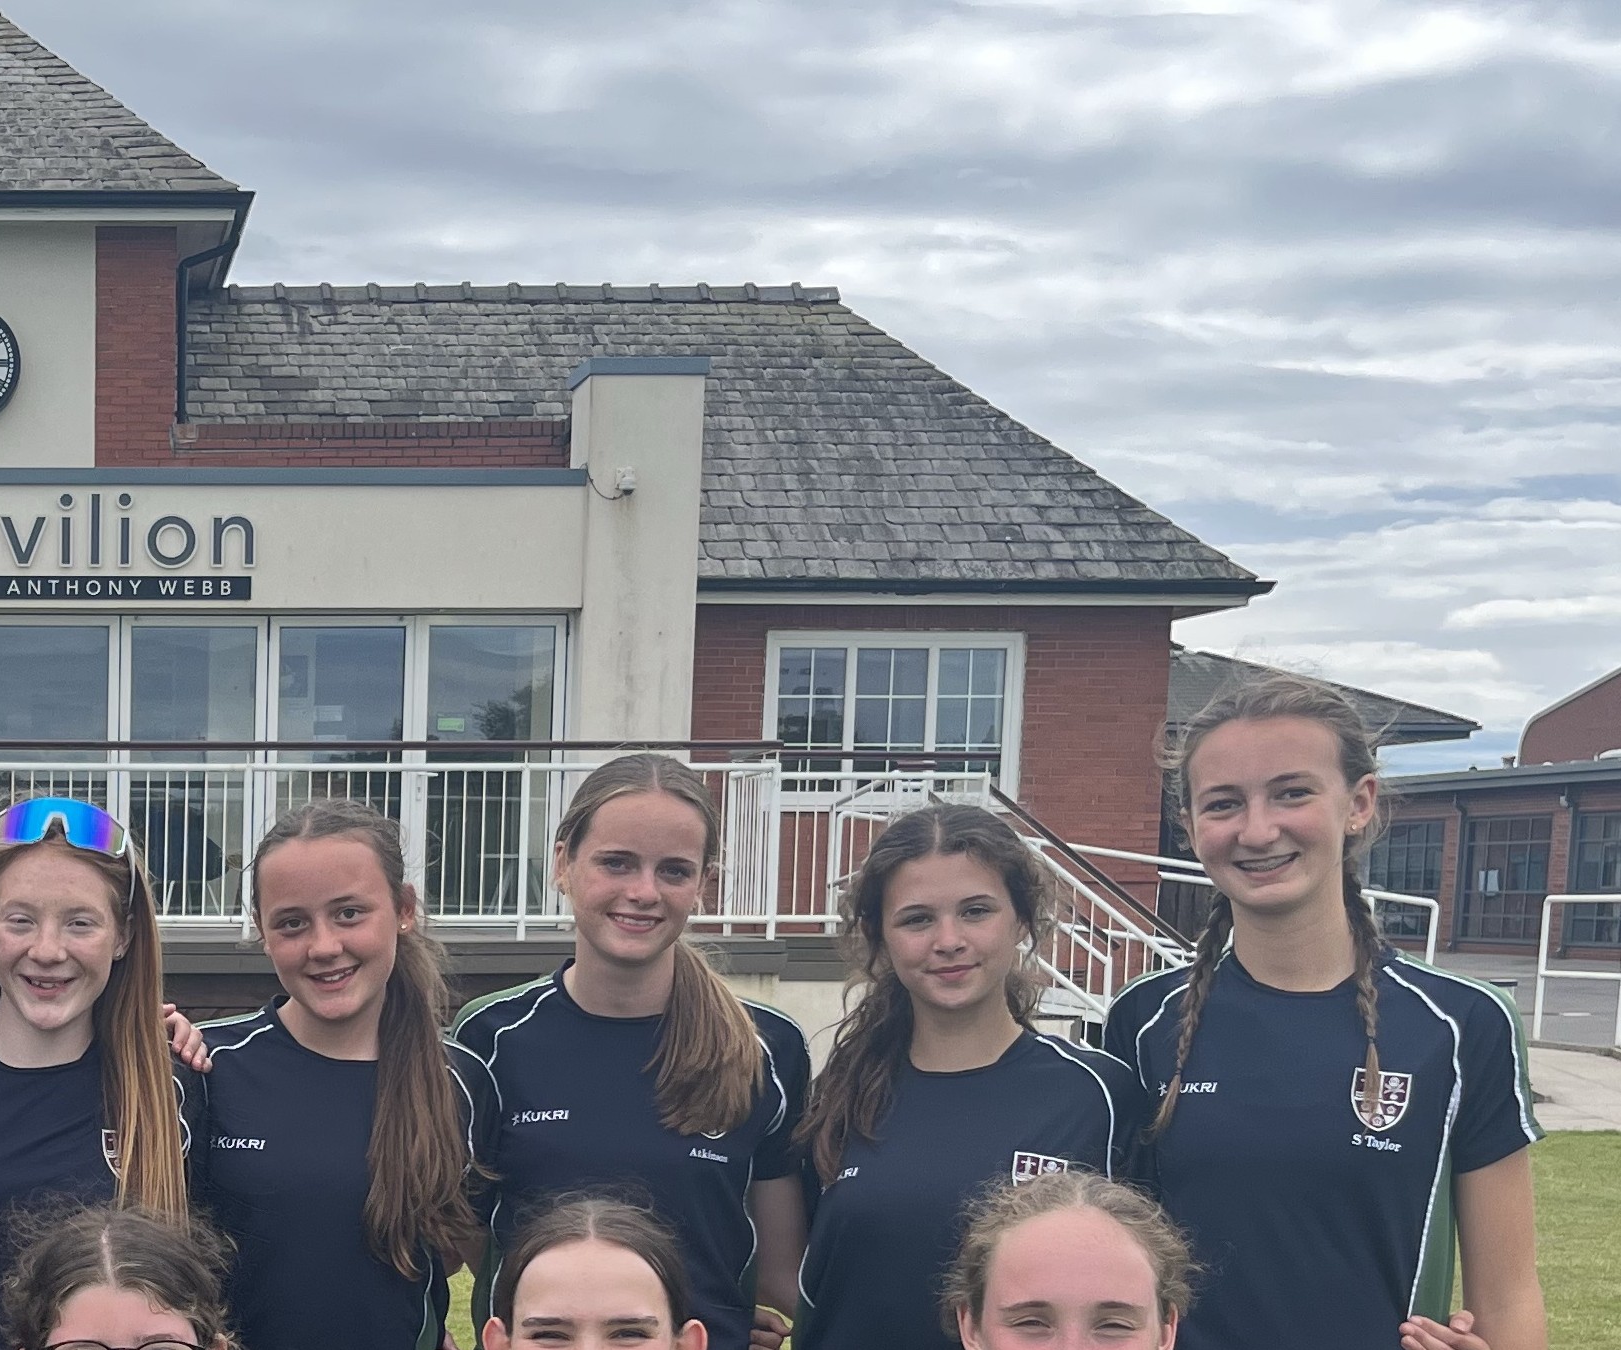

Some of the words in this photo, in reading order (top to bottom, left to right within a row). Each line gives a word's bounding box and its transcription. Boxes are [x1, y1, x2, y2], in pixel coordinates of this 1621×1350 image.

[6, 579, 142, 596] ANTHONY
[158, 579, 232, 596] WEBB
[1179, 1082, 1218, 1094] UKRI
[521, 1109, 570, 1123] KUKRI
[217, 1136, 266, 1150] KUKRI
[1351, 1133, 1363, 1146] S
[1364, 1135, 1402, 1152] Taylor
